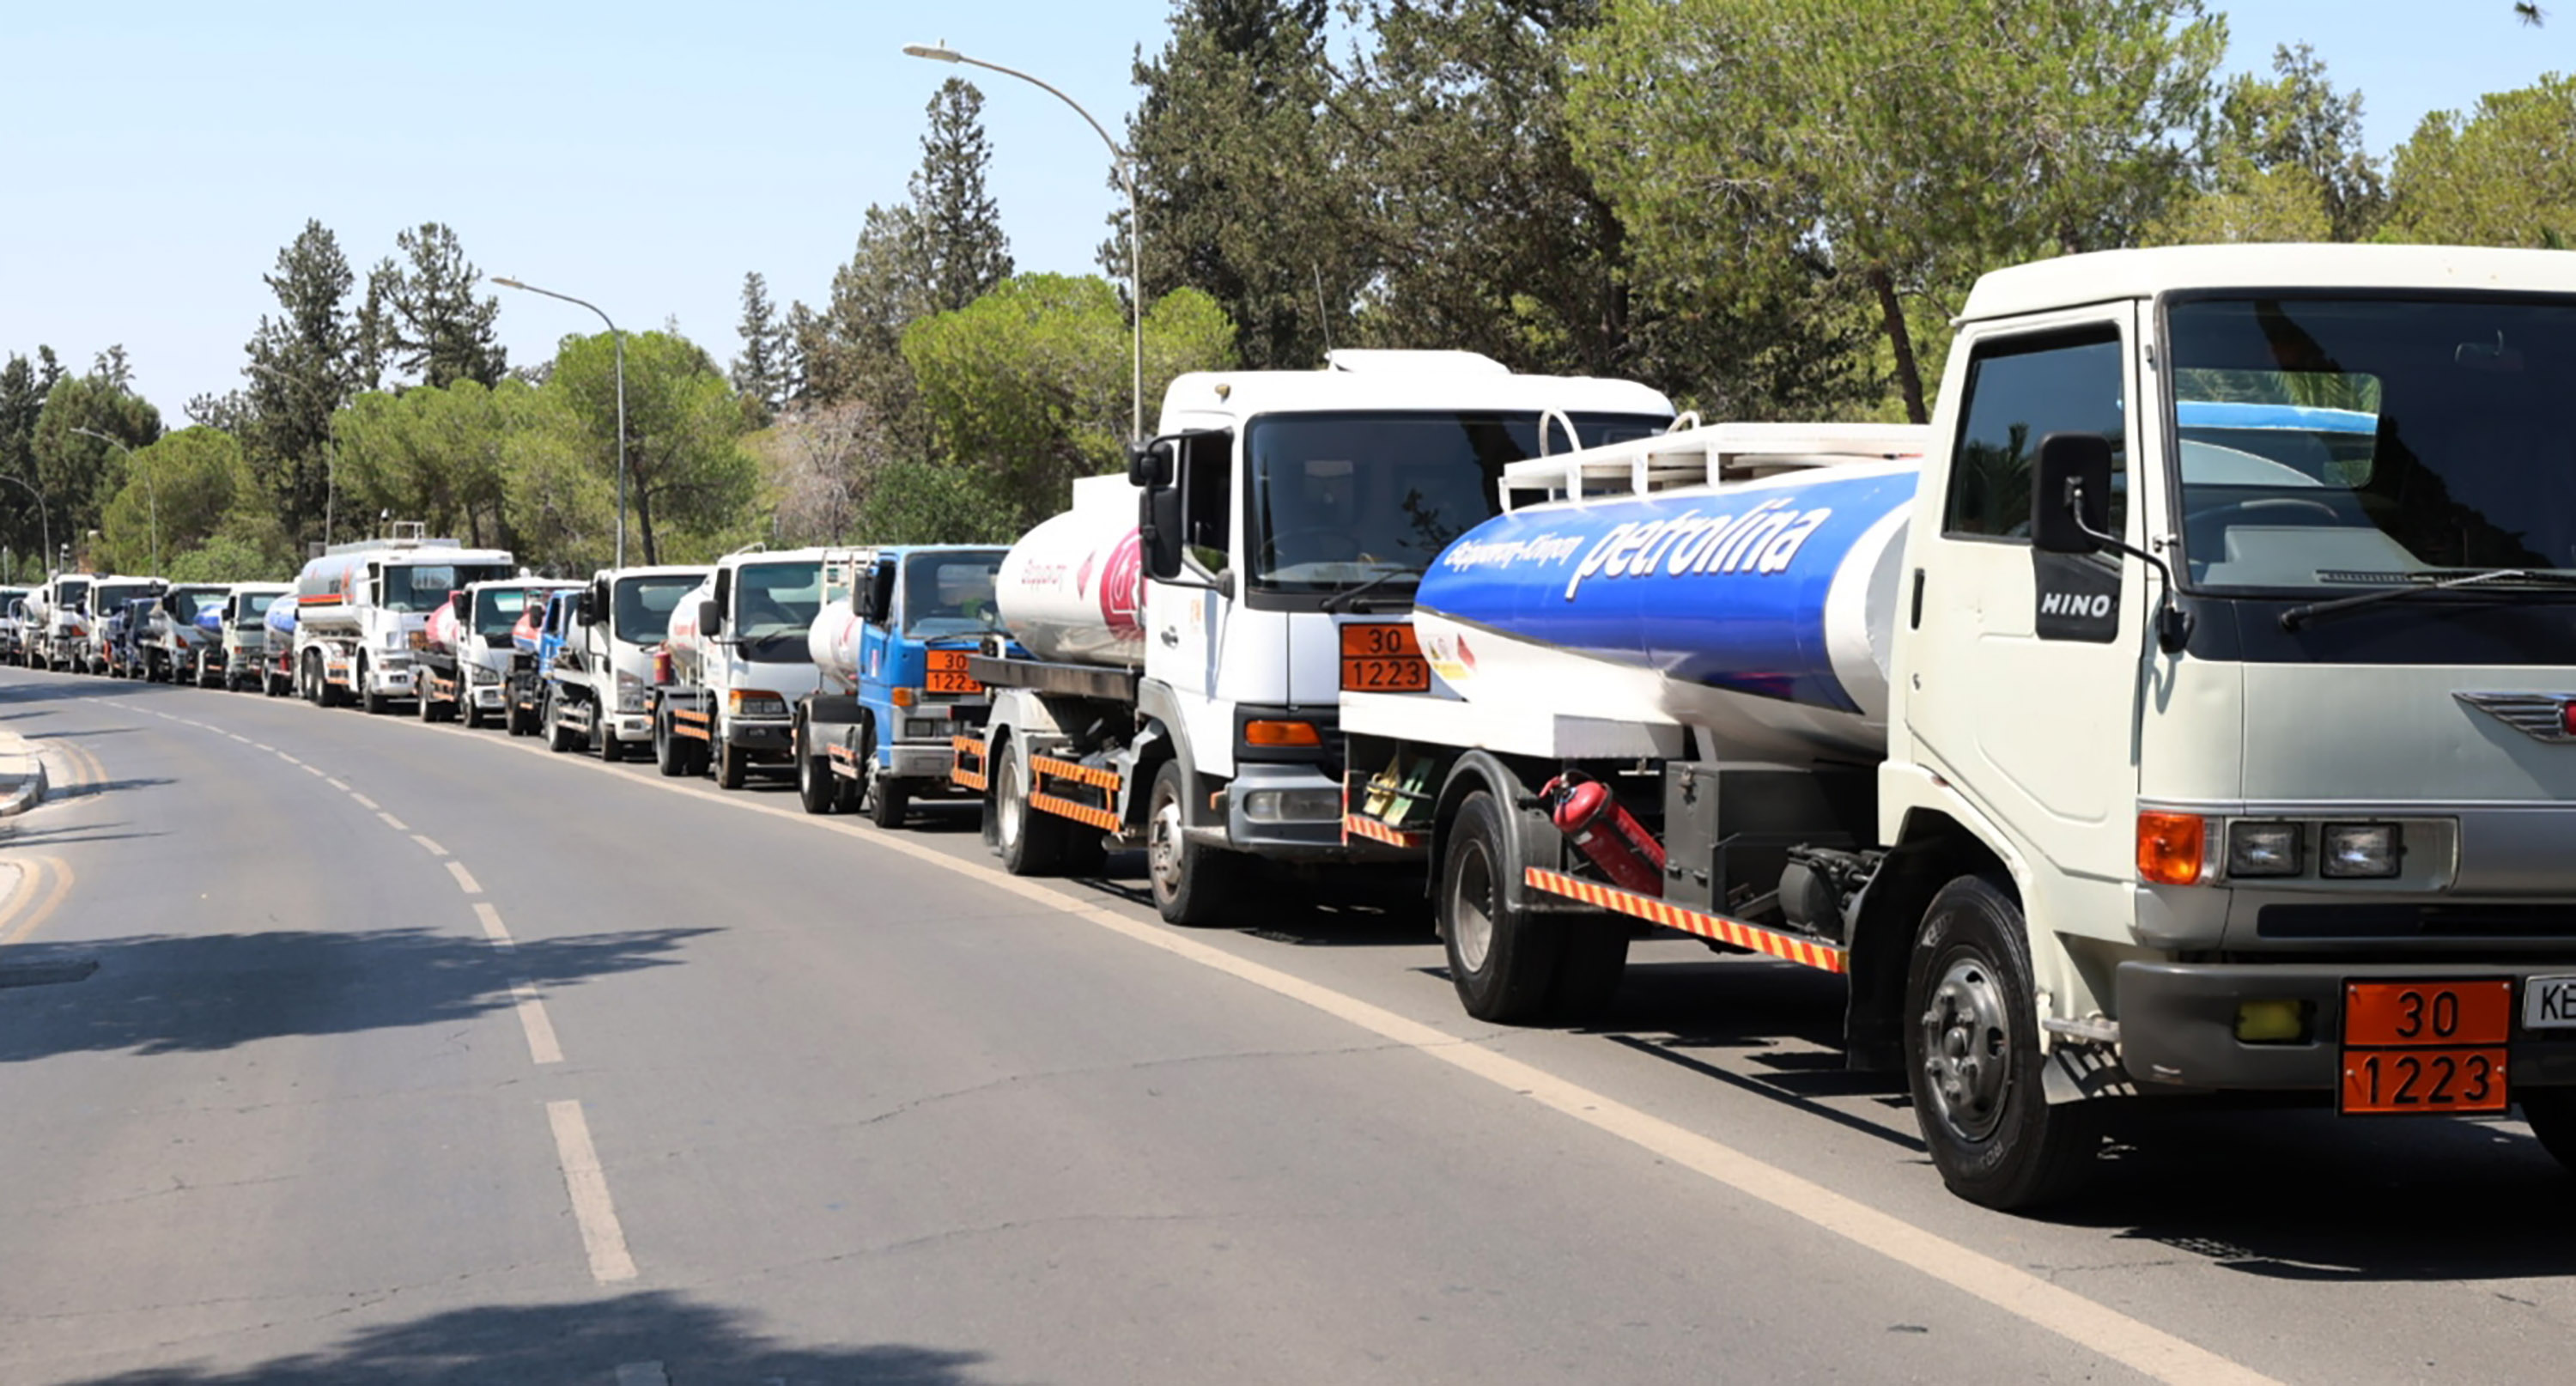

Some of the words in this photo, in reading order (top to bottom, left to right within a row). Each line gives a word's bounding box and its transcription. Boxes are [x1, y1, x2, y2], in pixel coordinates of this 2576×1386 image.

[1564, 496, 1832, 601] petrolina
[2040, 592, 2111, 618] HINO
[1368, 628, 1402, 654] 30
[945, 653, 968, 670] 30
[1353, 660, 1421, 686] 1223
[2396, 990, 2459, 1038] 30
[2363, 1054, 2490, 1105] 1223
